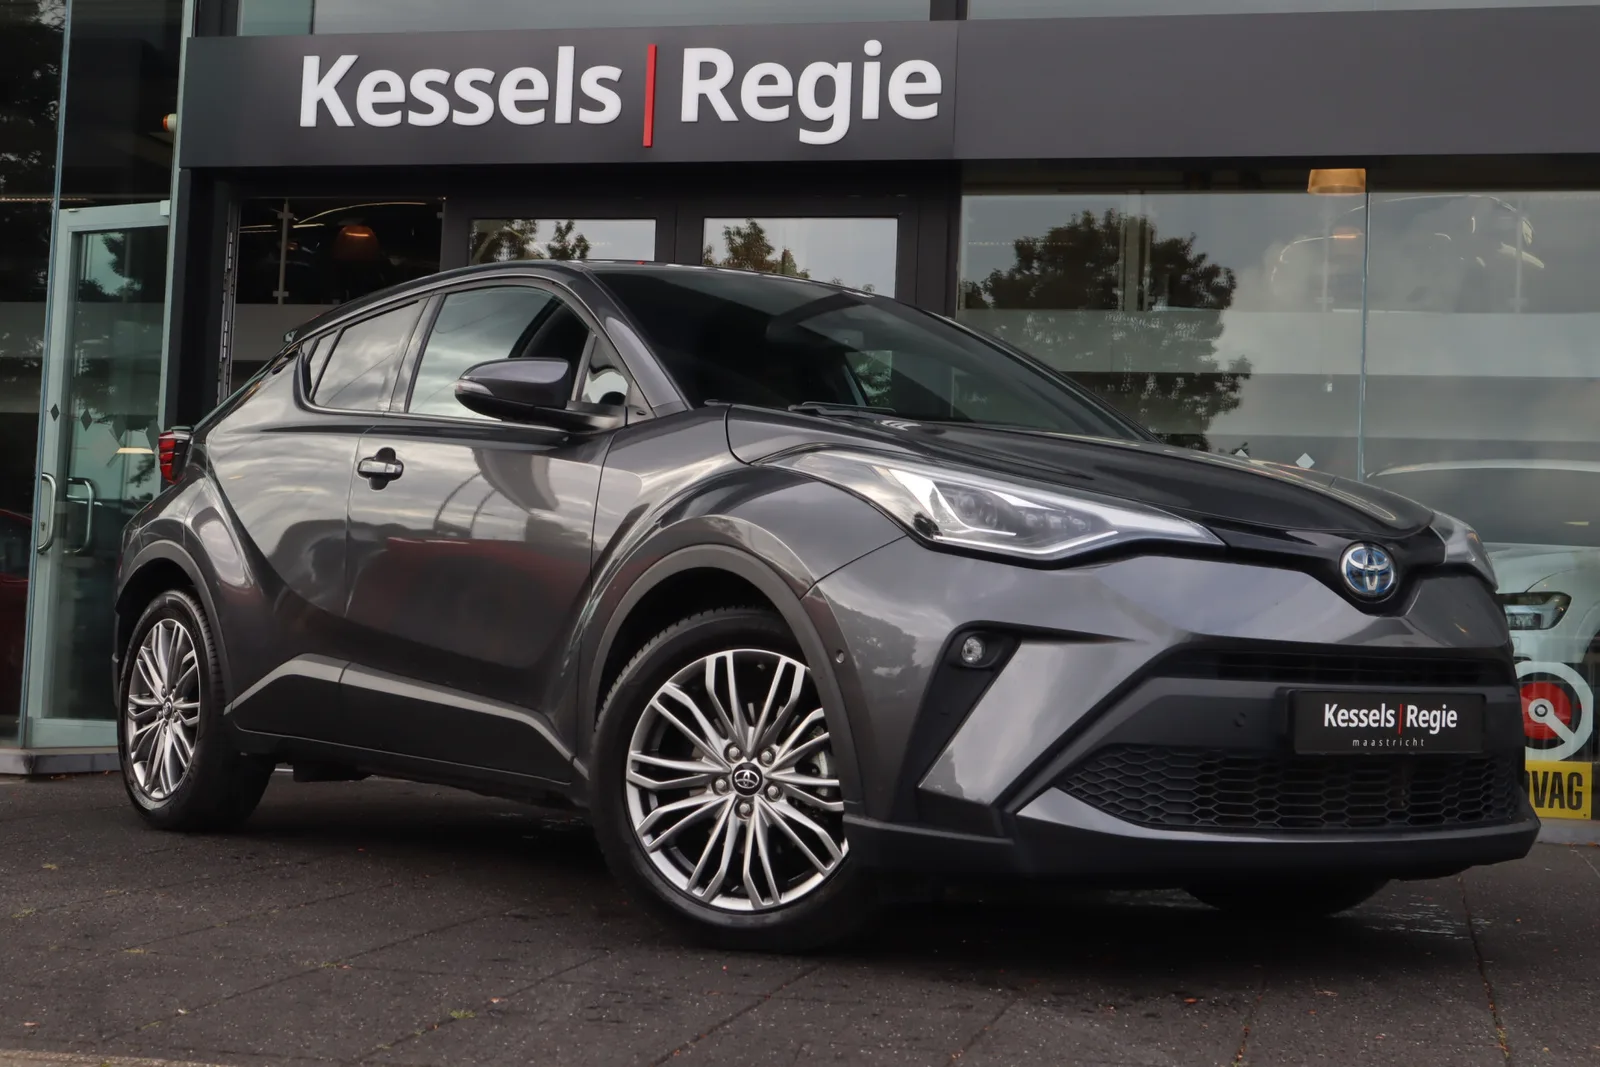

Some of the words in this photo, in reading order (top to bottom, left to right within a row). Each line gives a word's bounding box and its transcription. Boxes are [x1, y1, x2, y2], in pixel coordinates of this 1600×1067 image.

[299, 45, 623, 128] Kessels
[680, 39, 943, 145] Regie
[1323, 703, 1396, 728] Kessels
[1405, 704, 1458, 735] Regie
[1352, 737, 1425, 747] maastricht
